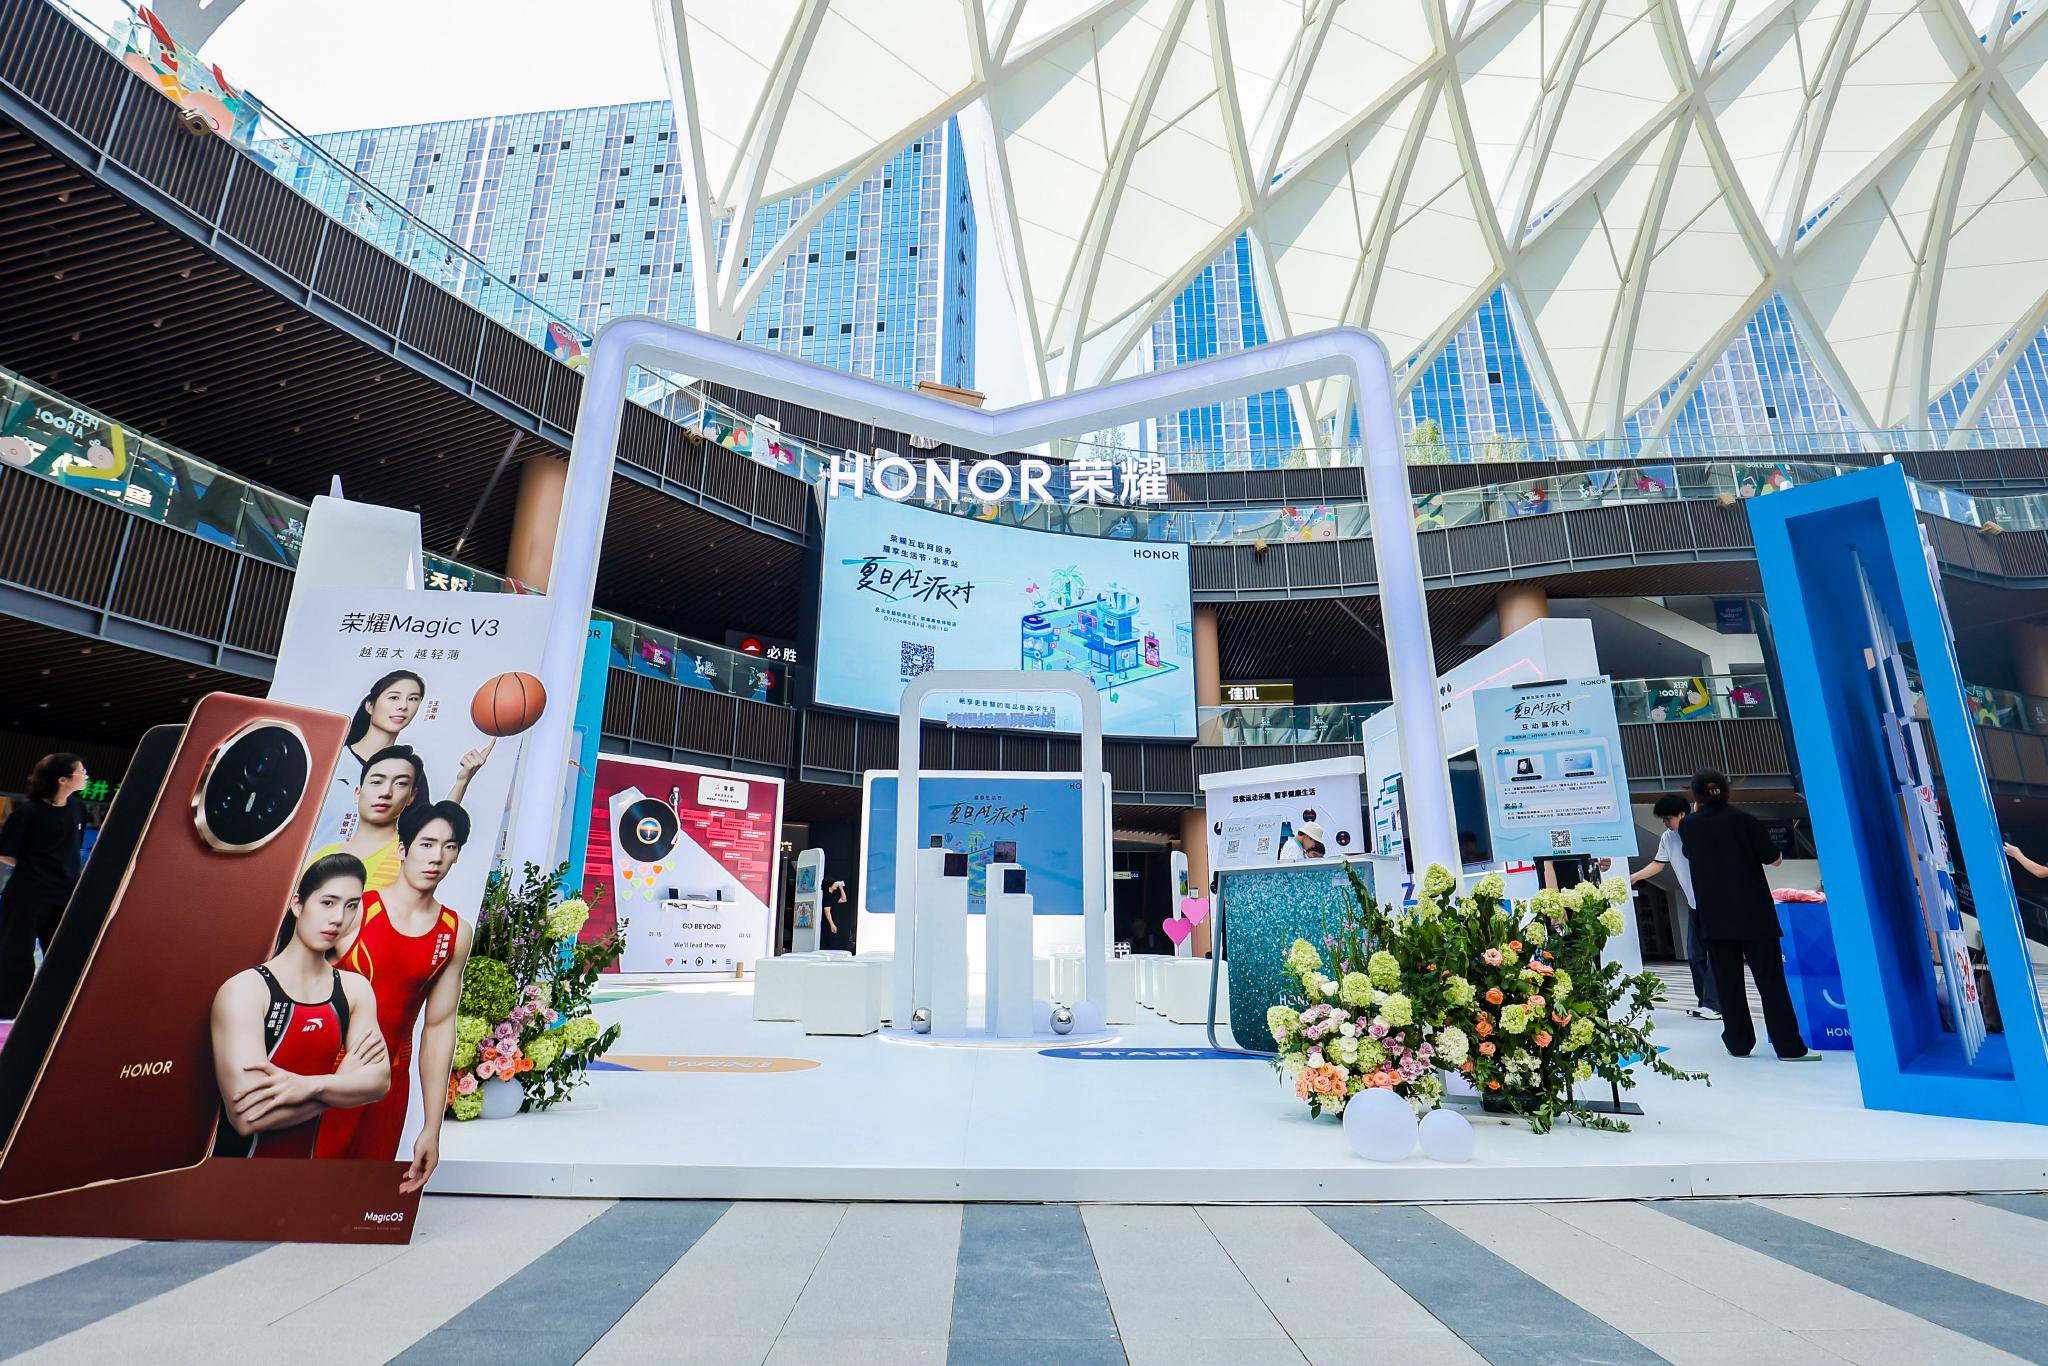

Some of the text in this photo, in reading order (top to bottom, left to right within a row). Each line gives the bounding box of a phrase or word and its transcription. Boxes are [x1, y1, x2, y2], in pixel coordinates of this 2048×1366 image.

[829, 453, 1169, 505] HONOR 荣耀
[1133, 549, 1180, 560] HONOR
[856, 556, 976, 610] 夏日AI派对
[339, 612, 500, 639] 荣耀Magic V3
[358, 647, 462, 661] 越强大 越轻薄
[766, 645, 797, 662] 必胜
[1580, 678, 1607, 686] HONOR
[1514, 701, 1572, 720] 夏日AI派对
[949, 802, 1029, 827] 夏日AI派对
[1826, 1027, 1852, 1037] HON
[119, 1060, 173, 1079] HONOR
[364, 1211, 404, 1224] MagicOS
